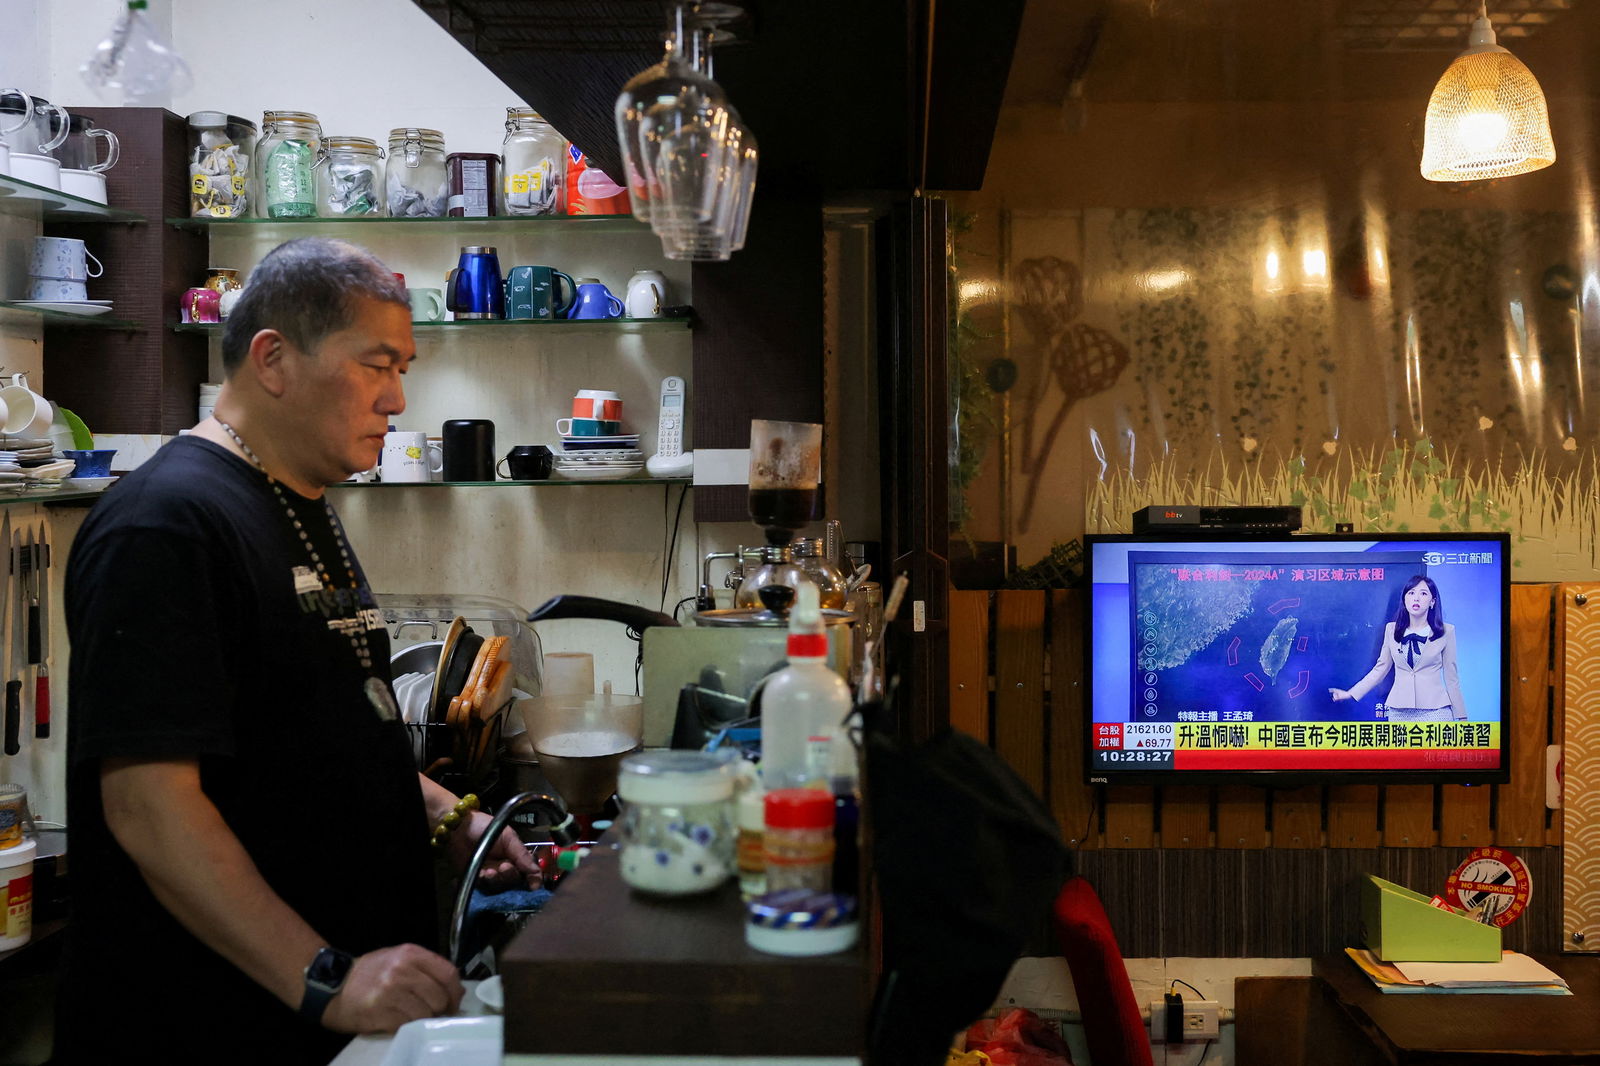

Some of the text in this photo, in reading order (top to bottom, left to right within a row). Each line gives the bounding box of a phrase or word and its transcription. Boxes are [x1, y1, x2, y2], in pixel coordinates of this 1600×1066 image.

[1446, 552, 1493, 564] 三立新聞
[1291, 567, 1385, 582] 演习区域示意图
[1177, 710, 1218, 722] 特報主播
[1098, 725, 1120, 735] 台股
[1126, 724, 1172, 734] 21621.60
[1258, 723, 1492, 748] 中國宣布今明展開聯合利劍演習
[1098, 737, 1120, 747] 加權
[1145, 738, 1172, 748] 69.77
[1100, 751, 1172, 762] 10:28:27
[1460, 881, 1514, 894] NO SMOKING
